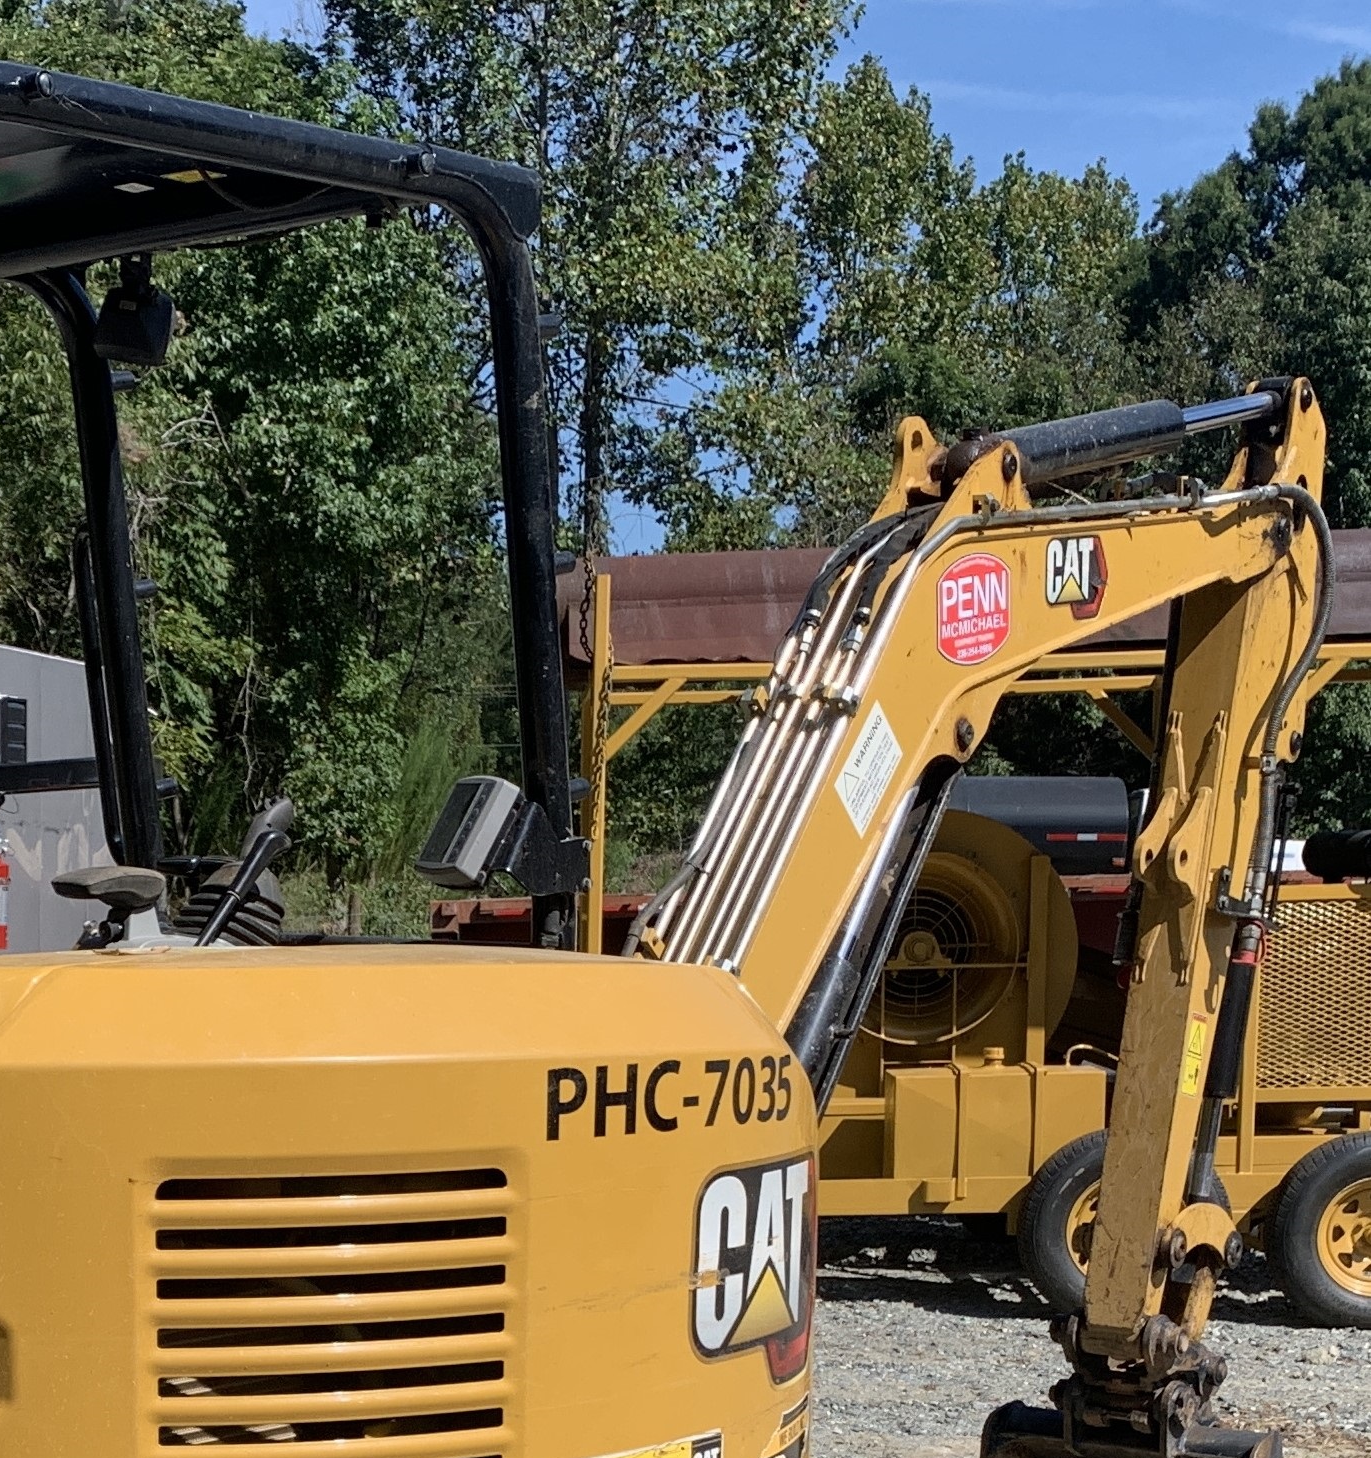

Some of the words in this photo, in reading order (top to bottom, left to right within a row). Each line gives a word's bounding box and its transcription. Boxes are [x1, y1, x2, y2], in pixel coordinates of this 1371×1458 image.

[942, 569, 1007, 622] PENN
[1047, 537, 1094, 604] CAT
[941, 613, 1007, 639] MCMICHAEL
[853, 714, 884, 768] WARNING
[546, 1055, 791, 1141] PHC-7035
[696, 1160, 809, 1350] CAT
